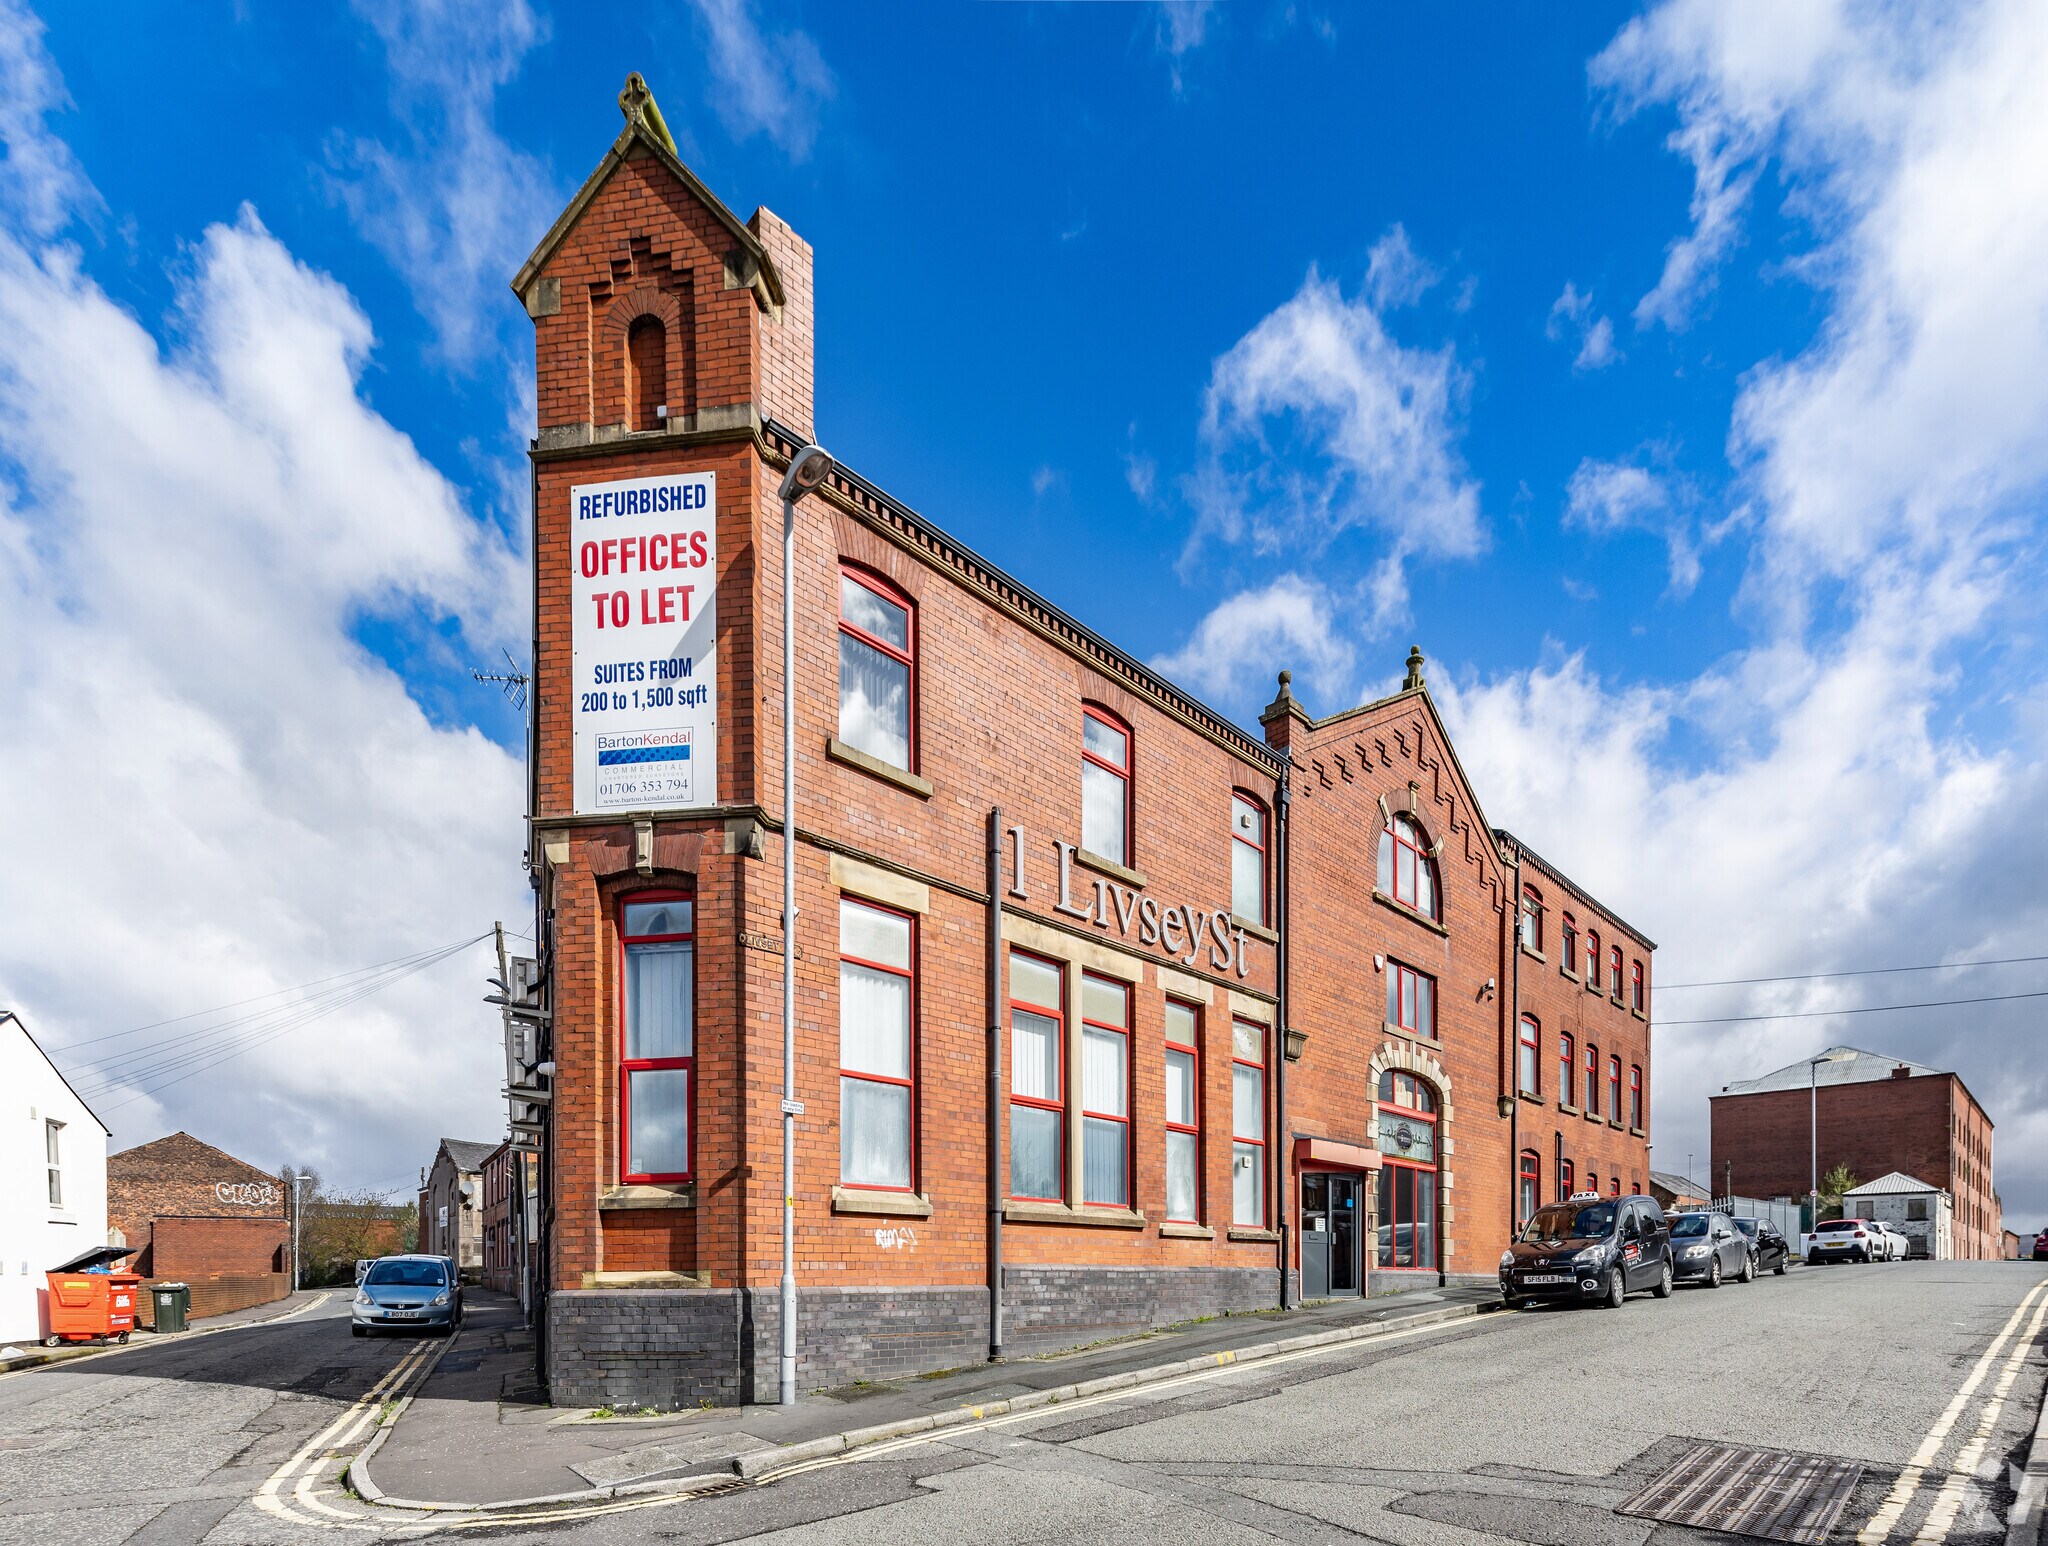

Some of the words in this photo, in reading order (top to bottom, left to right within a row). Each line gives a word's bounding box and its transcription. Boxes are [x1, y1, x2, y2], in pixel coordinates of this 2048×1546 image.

[580, 484, 706, 520] REFURBISHED
[581, 530, 708, 579] OFFICES
[592, 590, 630, 629] TO
[641, 585, 695, 625] LET
[594, 661, 645, 685] SUITES
[649, 657, 692, 680] FROM
[581, 691, 608, 712] 200
[613, 691, 627, 710] to
[632, 686, 674, 711] 1,500
[678, 684, 707, 709] sqft
[598, 731, 691, 749] BartonKendal
[604, 763, 683, 775] COMMERCIAL
[599, 782, 637, 795] 01706
[640, 780, 662, 793] 353
[666, 778, 689, 790] 794
[603, 793, 685, 804] www.barton-kendal.co.uk
